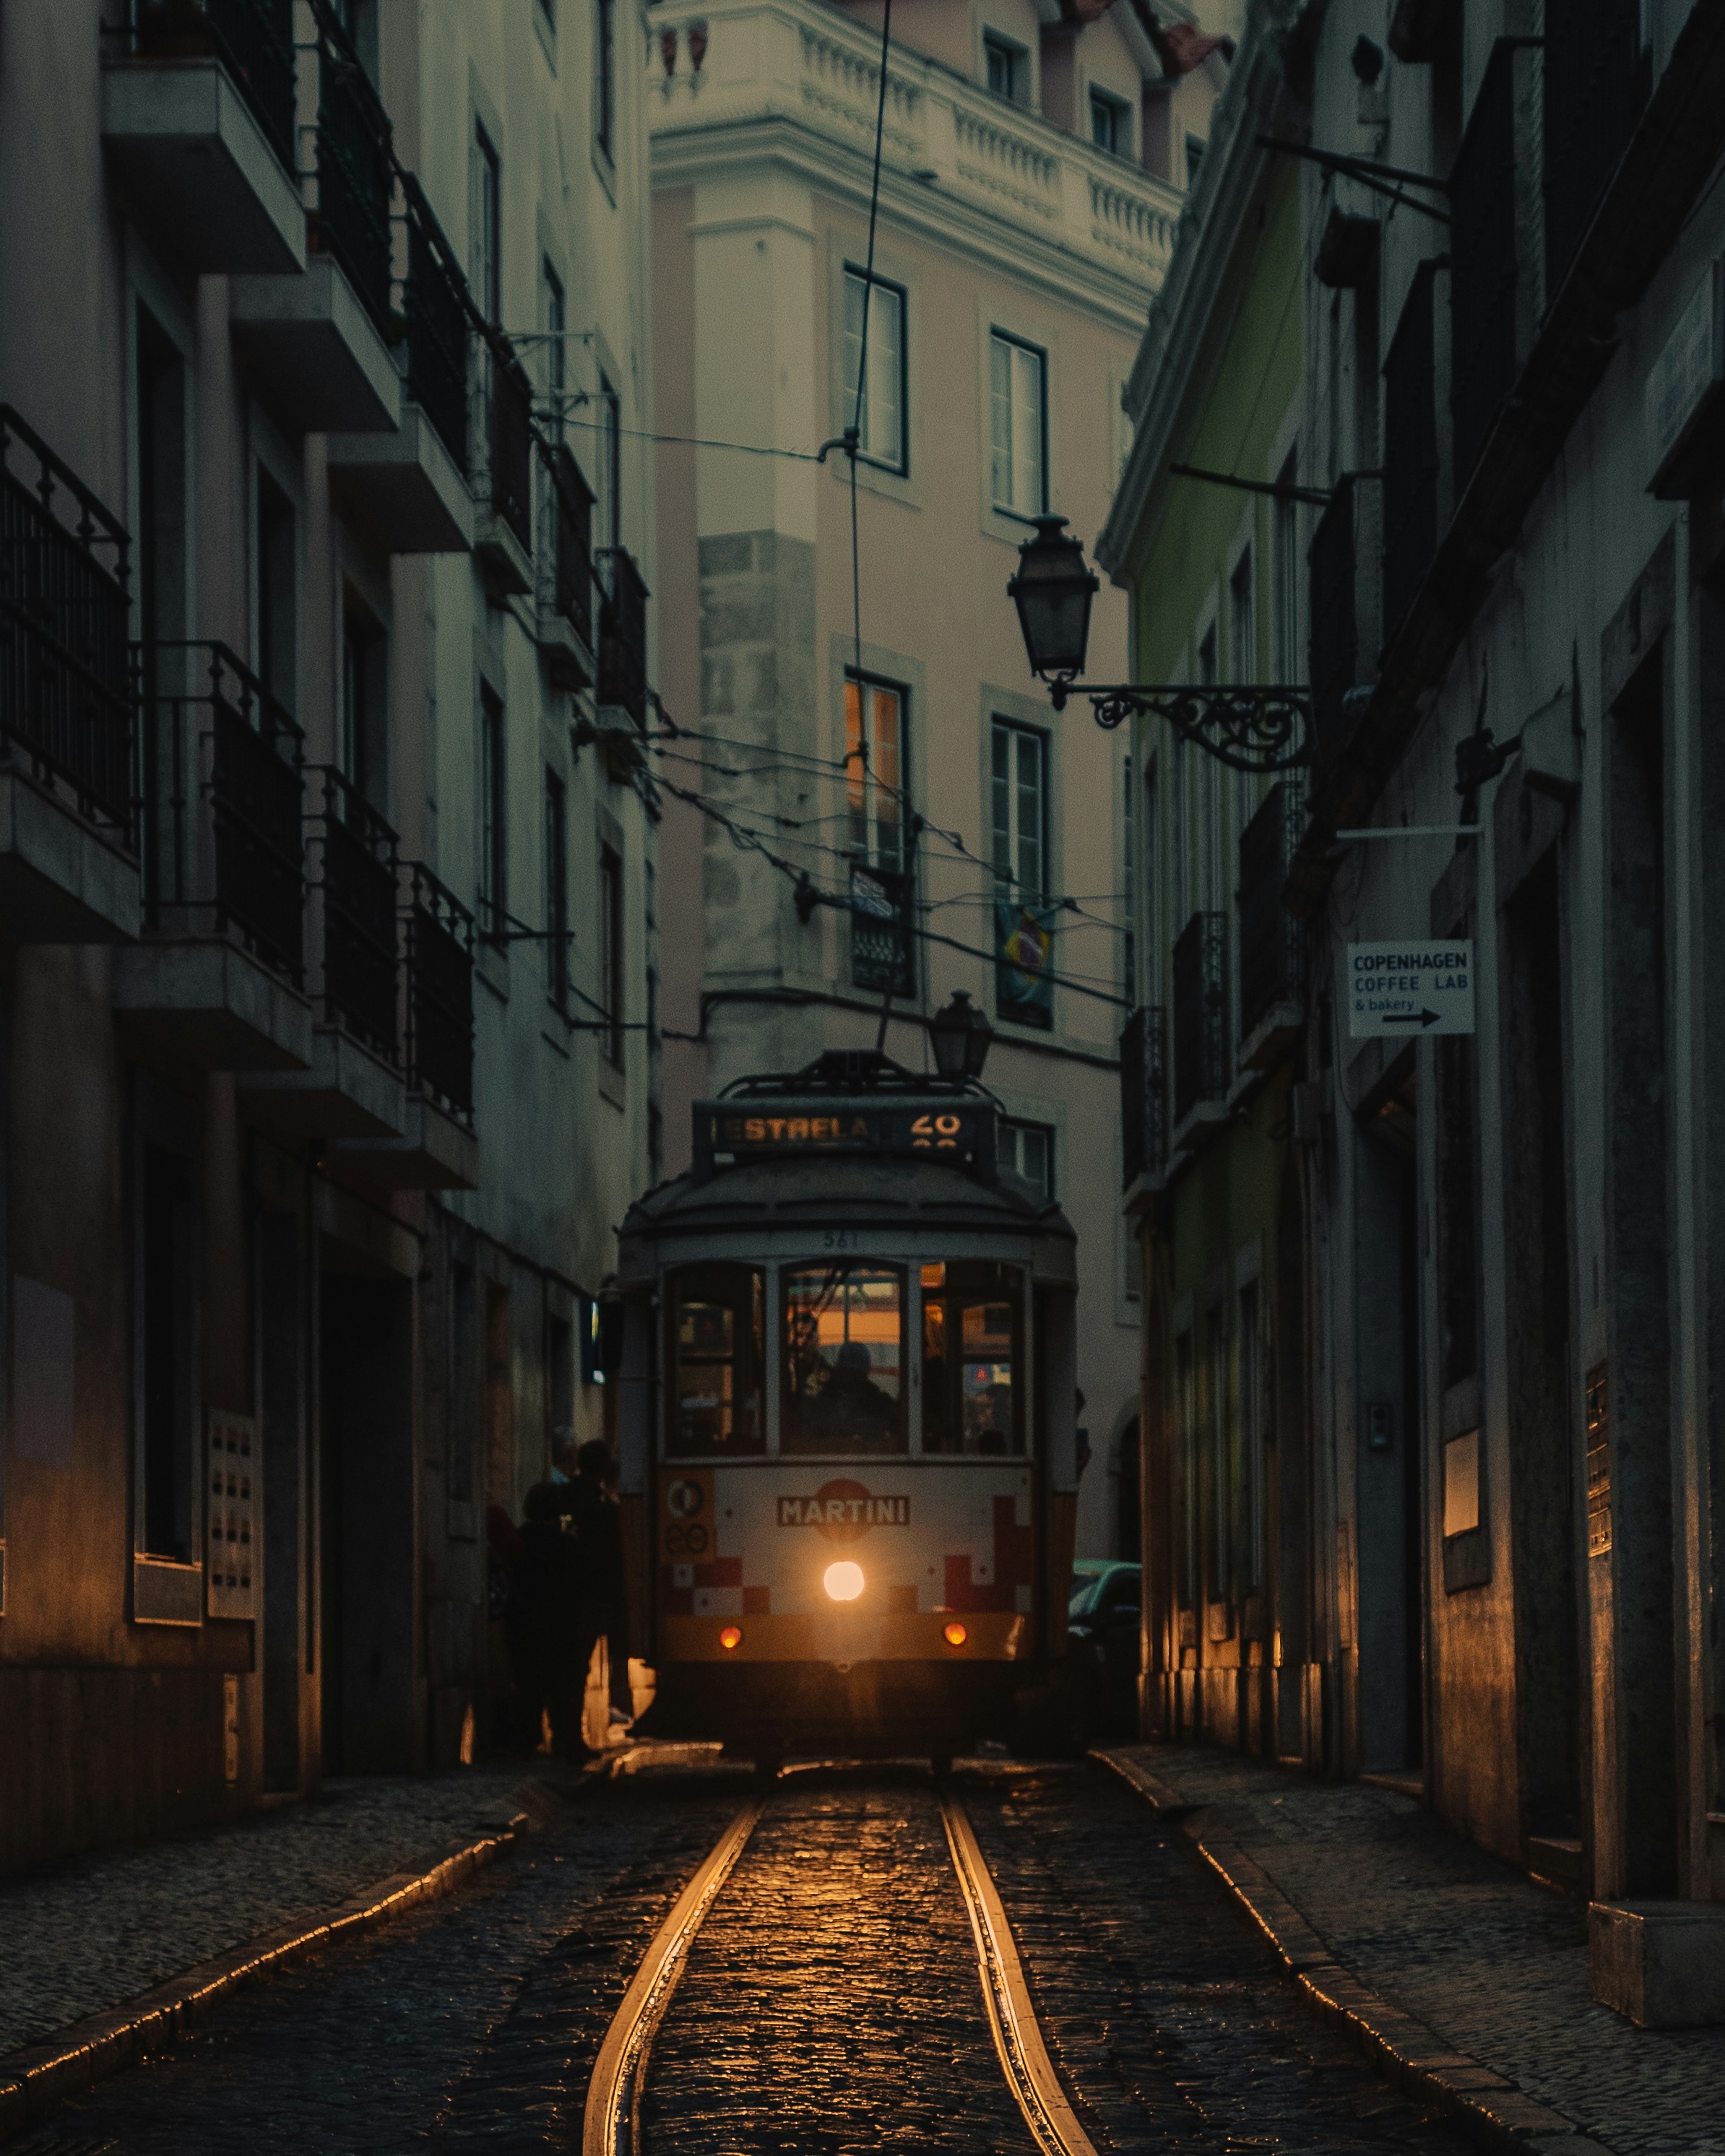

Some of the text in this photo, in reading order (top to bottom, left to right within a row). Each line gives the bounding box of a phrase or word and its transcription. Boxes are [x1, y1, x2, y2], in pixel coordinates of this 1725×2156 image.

[1354, 953, 1467, 971] COPENHAGEN
[1355, 974, 1468, 992] COFFEE LAB
[1355, 998, 1414, 1011] & bakery
[726, 1117, 868, 1140] ESTRELA
[780, 1499, 906, 1524] MARTINI
